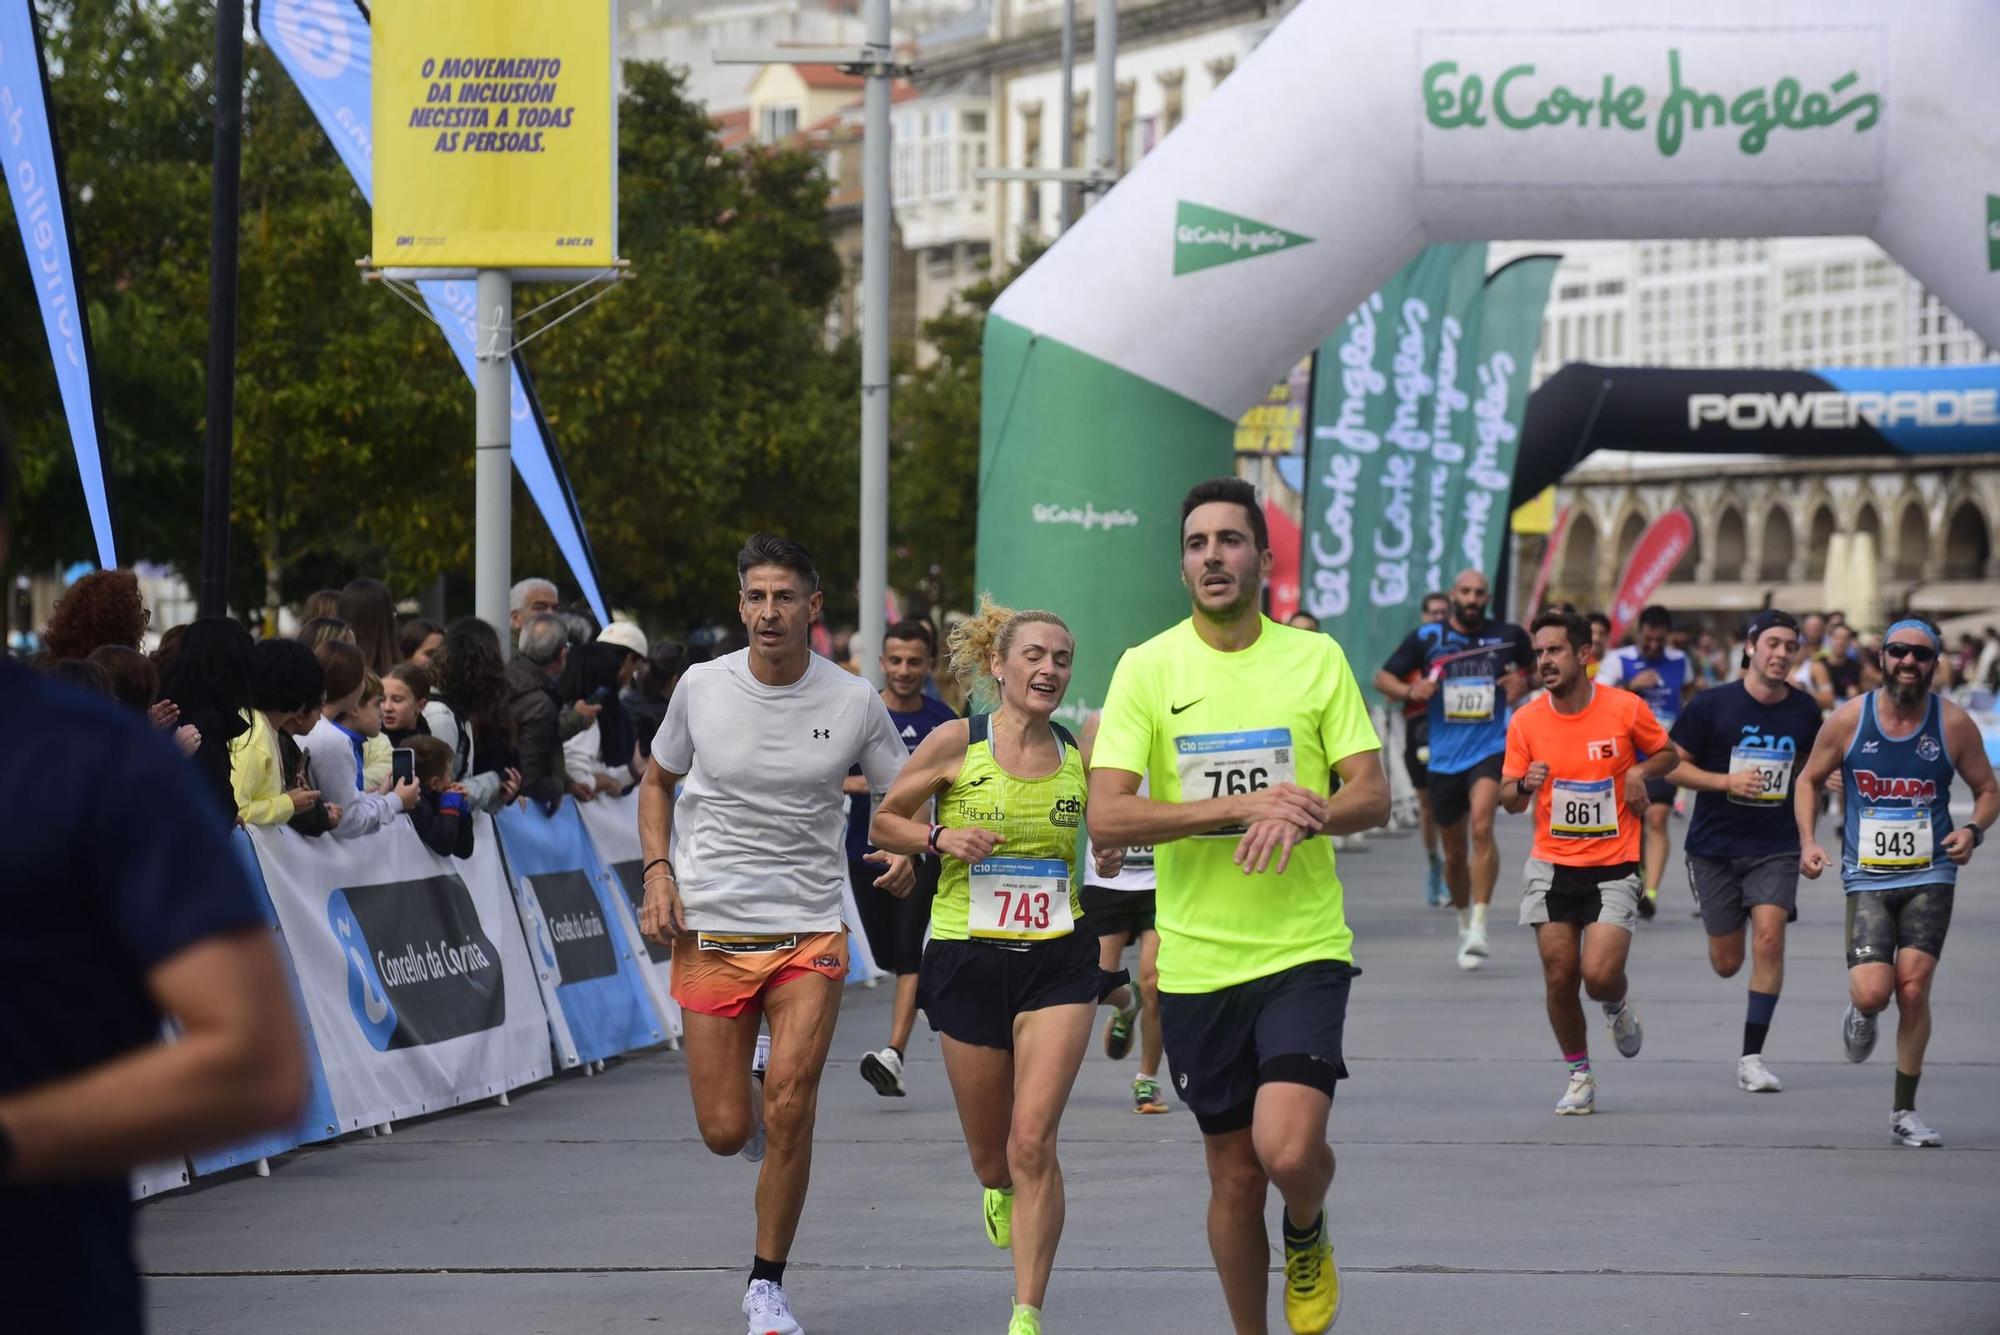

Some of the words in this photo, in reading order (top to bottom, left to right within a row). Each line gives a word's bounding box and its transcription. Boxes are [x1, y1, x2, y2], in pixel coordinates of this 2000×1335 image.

[421, 58, 435, 79] O
[438, 58, 561, 79] MOVEMENTO
[426, 83, 451, 102] DA
[458, 78, 556, 103] INCLUSIÓN
[1423, 60, 1487, 129] El
[1493, 64, 1646, 130] Corte
[1657, 48, 1881, 157] Inglés
[409, 107, 489, 127] NECESITA
[495, 107, 508, 127] A
[517, 107, 574, 127] TODAS
[434, 132, 460, 152] AS
[462, 132, 545, 152] PERSOAS.
[1464, 351, 1517, 491] Inglés
[1688, 389, 2000, 430] POWERADE
[1311, 453, 1362, 567] Corte
[1373, 454, 1416, 559] Corte
[1462, 490, 1493, 572] orte
[1306, 569, 1350, 619] El
[1370, 560, 1410, 606] El
[1204, 767, 1269, 798] 766
[1756, 768, 1783, 792] 34
[1565, 801, 1601, 825] 861
[1875, 831, 1915, 857] 943
[973, 864, 991, 873] C10
[994, 891, 1050, 929] 743
[378, 943, 428, 987] Concello
[426, 940, 446, 979] da
[813, 956, 841, 968] HOKA
